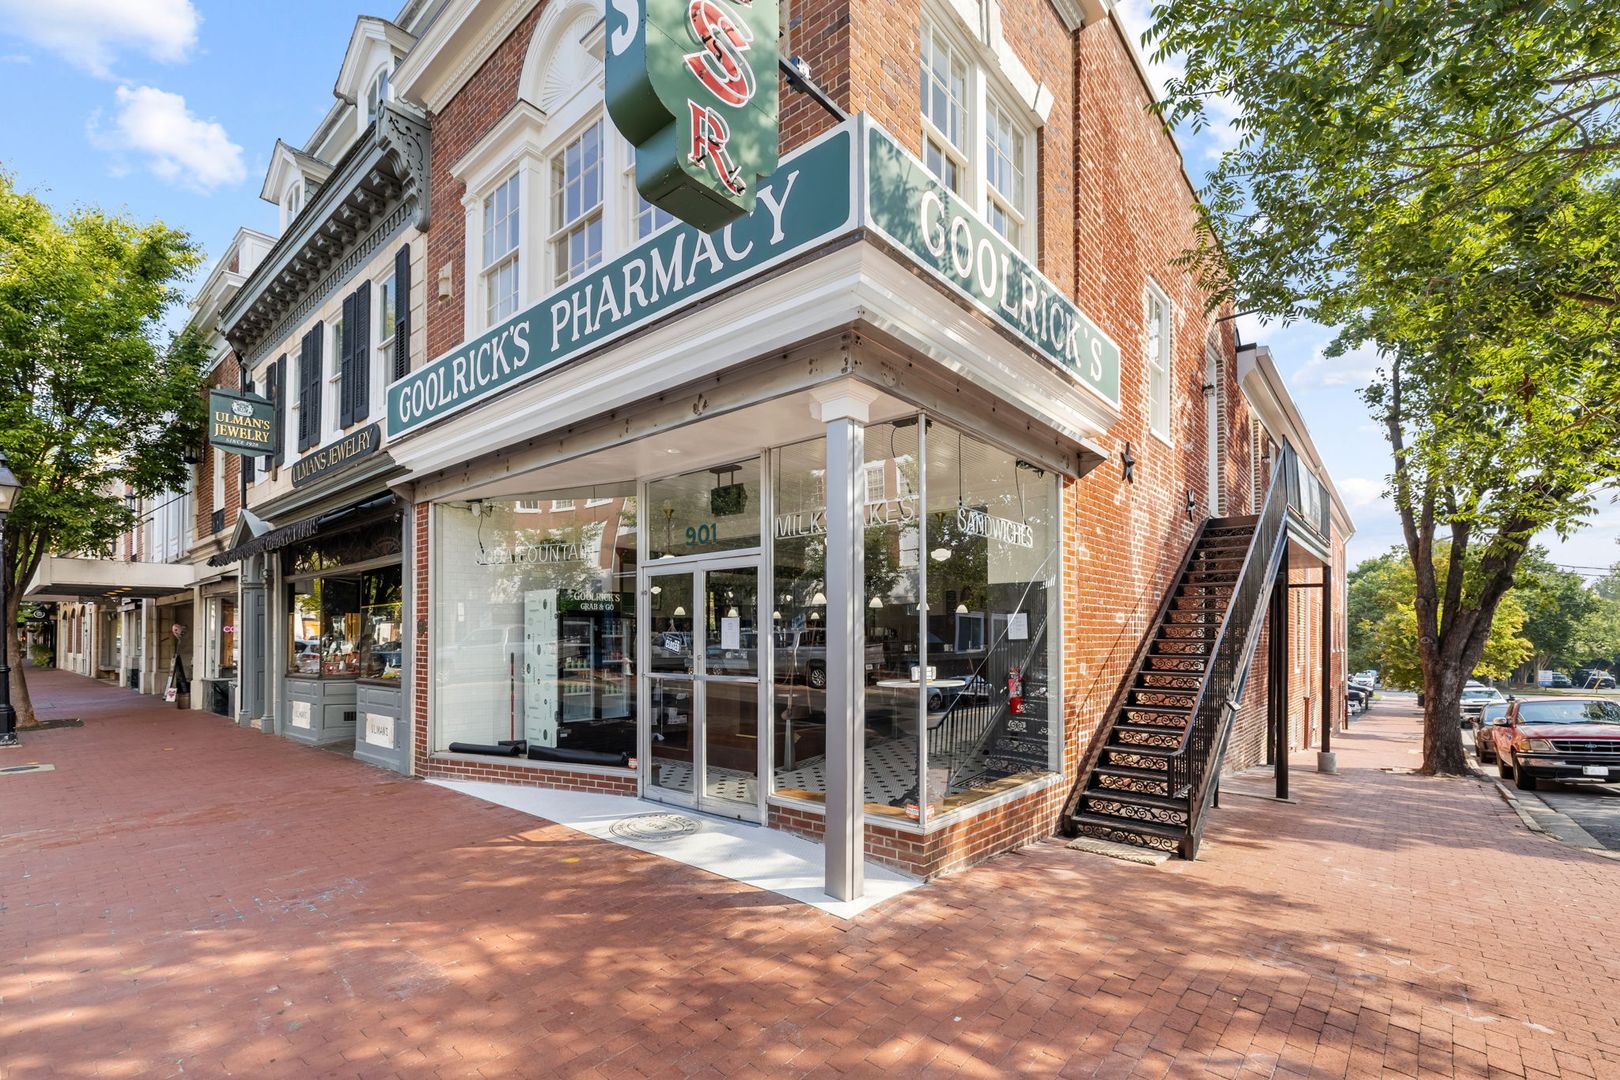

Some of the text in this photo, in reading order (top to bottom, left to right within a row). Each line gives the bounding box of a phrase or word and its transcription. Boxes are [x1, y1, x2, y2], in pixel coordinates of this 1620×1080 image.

[399, 169, 800, 423] GOOLRICK'S PHARMACY
[920, 190, 1103, 382] GOOLRICK'S
[214, 422, 270, 443] JEWELRY
[215, 411, 270, 430] ULMAN'S
[327, 428, 373, 467] JEWELRY
[776, 497, 914, 537] MILKKES
[957, 507, 1034, 548] SANDWICHES
[686, 522, 719, 546] 901
[574, 591, 621, 602] GOOLRICK'S
[580, 602, 598, 611] GRAB
[604, 603, 615, 611] GO
